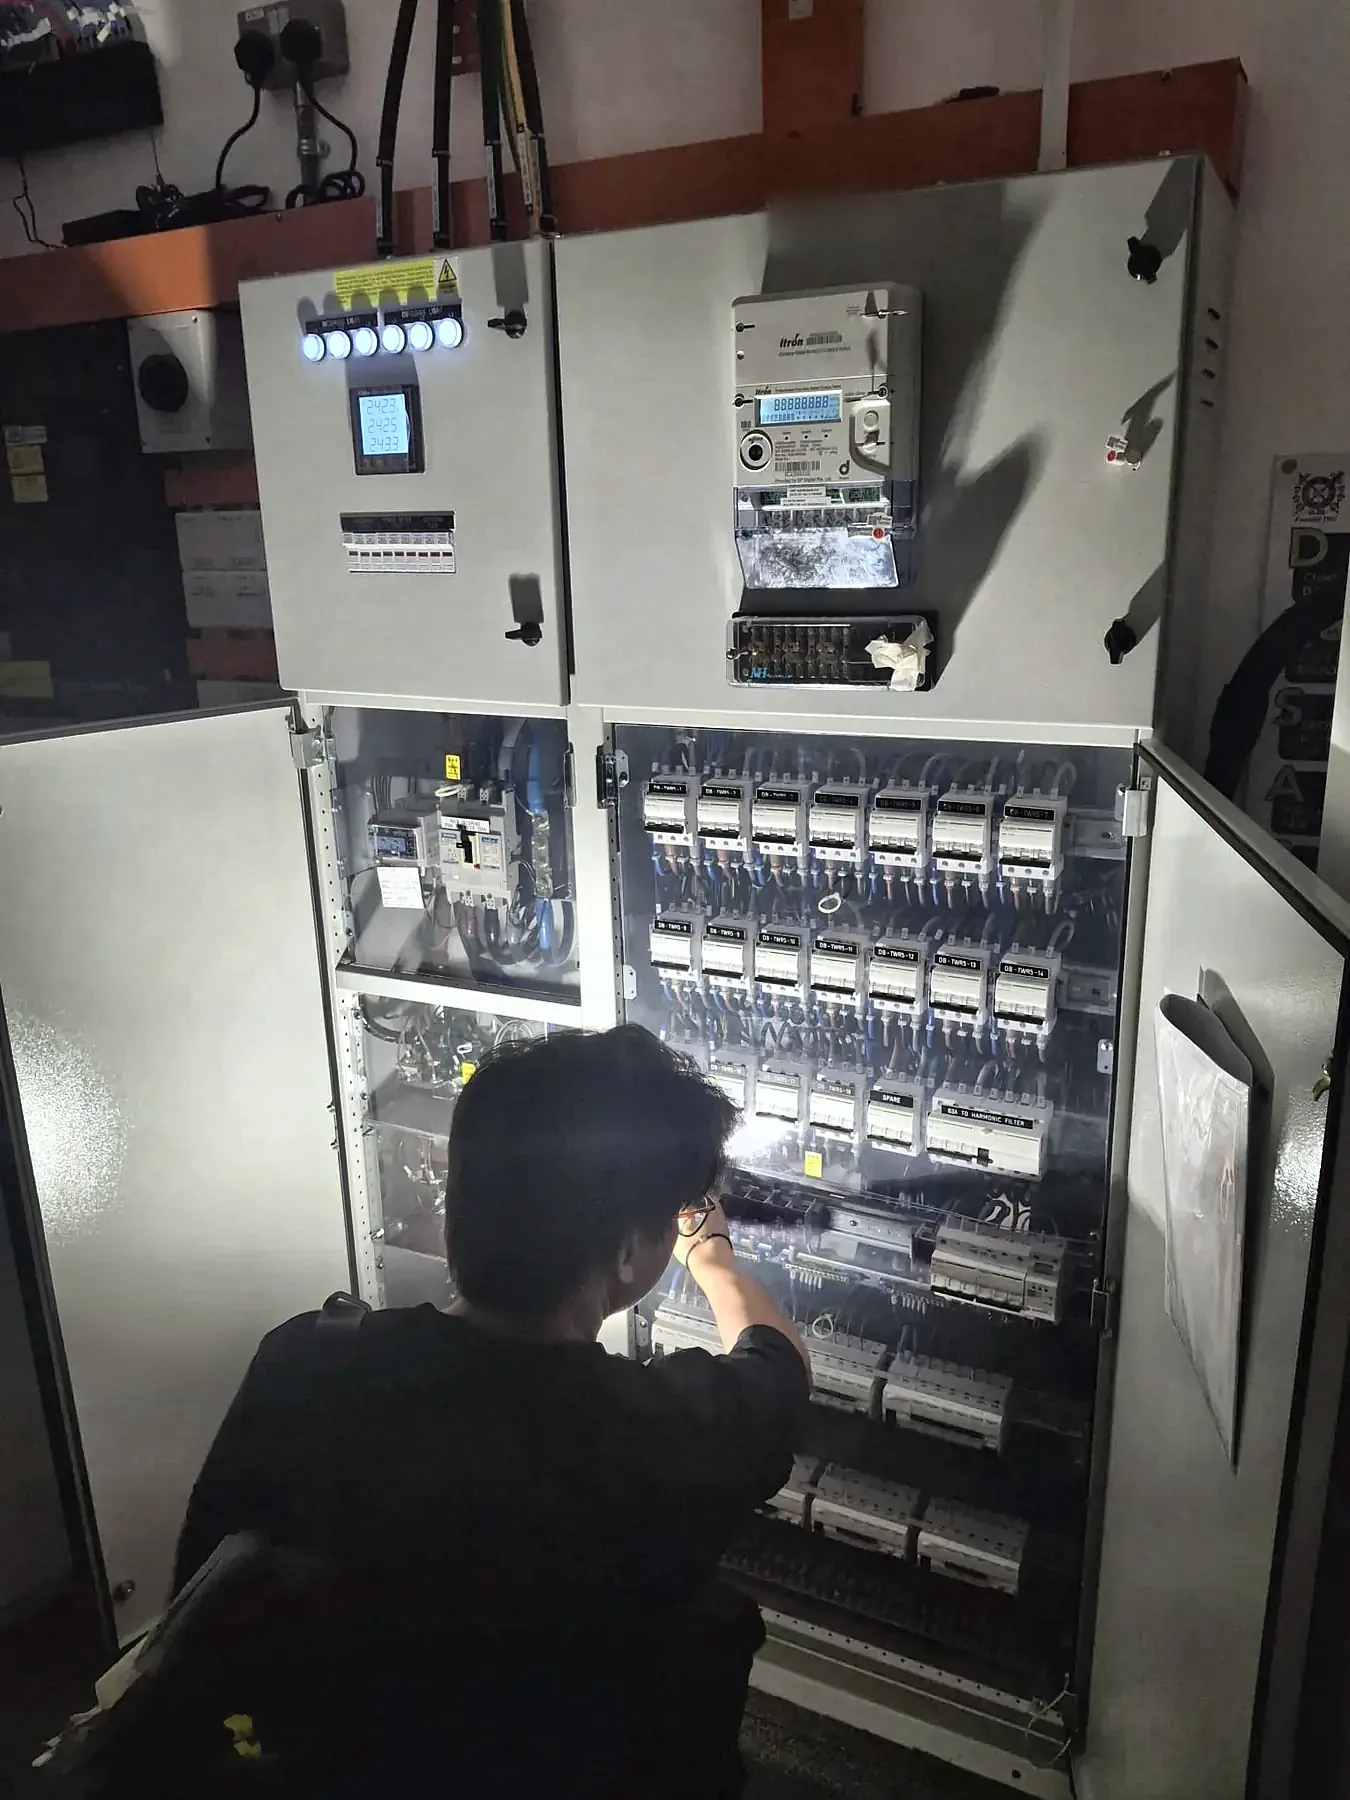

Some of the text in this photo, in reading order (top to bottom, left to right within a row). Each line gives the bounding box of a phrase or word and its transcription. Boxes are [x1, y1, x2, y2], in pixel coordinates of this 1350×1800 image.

[1288, 527, 1329, 569] D
[882, 1094, 901, 1104] SPARE
[971, 1112, 1002, 1123] HARMONIC
[1004, 1118, 1025, 1127] FILTER
